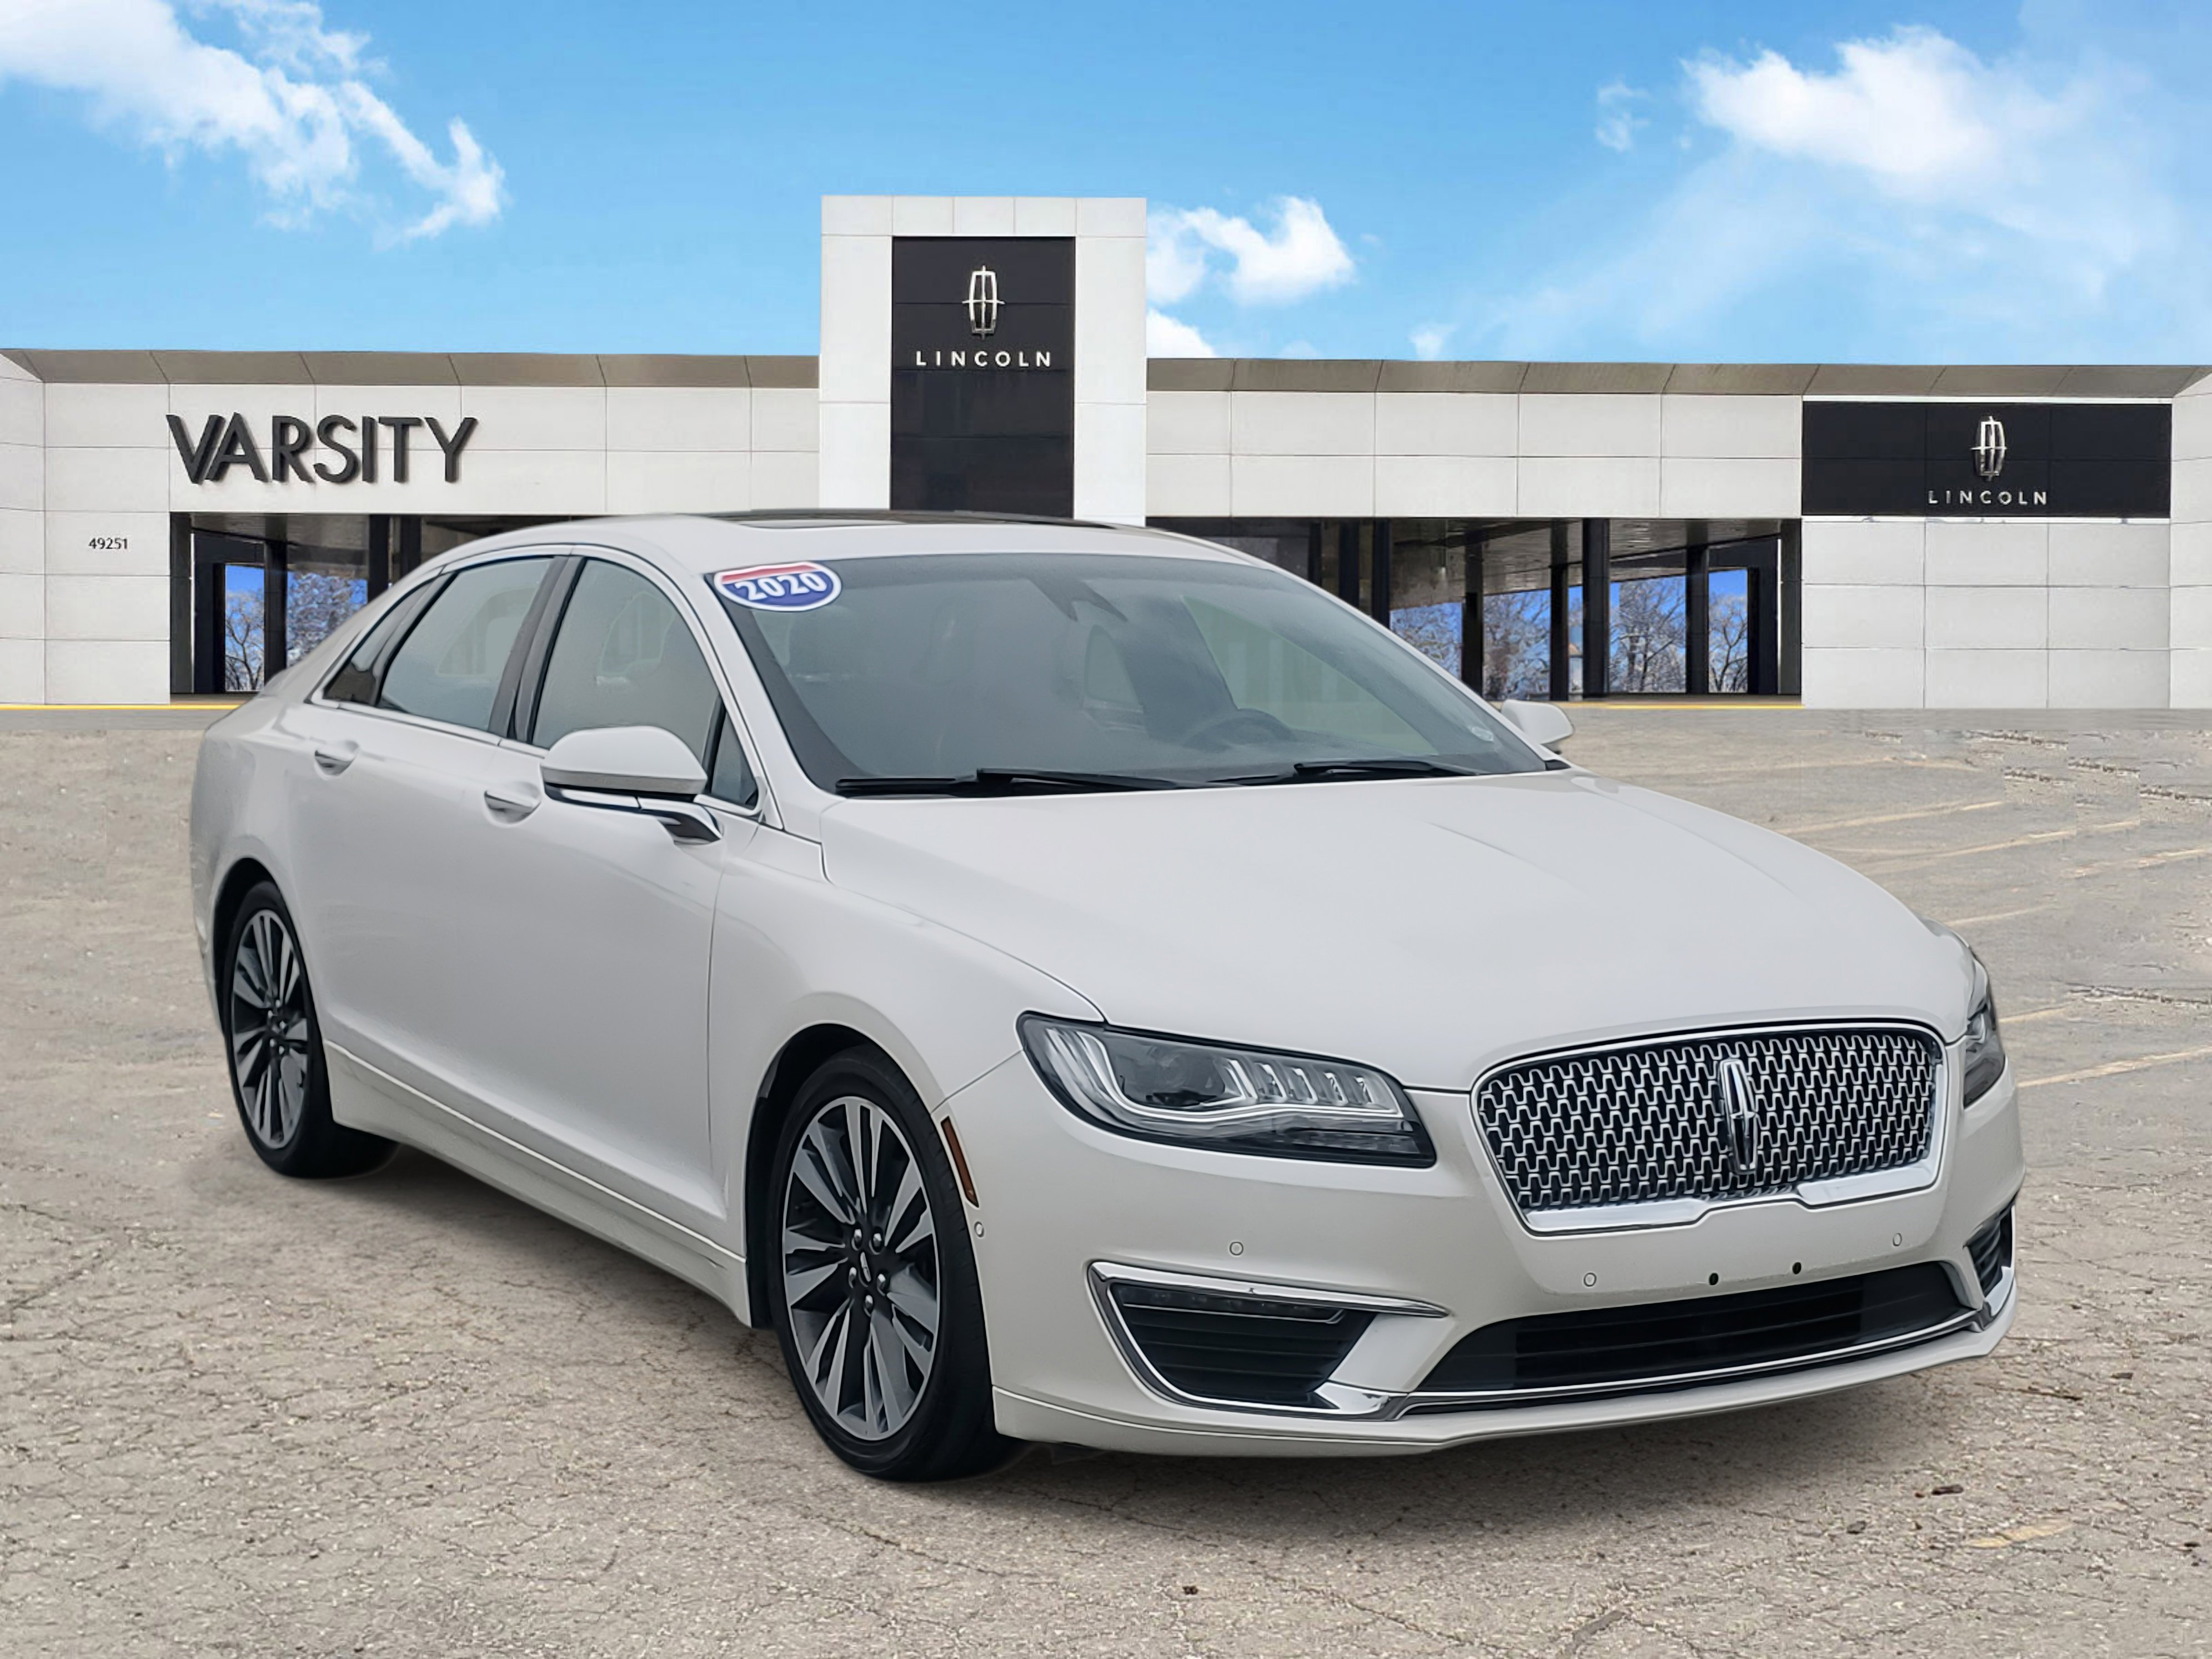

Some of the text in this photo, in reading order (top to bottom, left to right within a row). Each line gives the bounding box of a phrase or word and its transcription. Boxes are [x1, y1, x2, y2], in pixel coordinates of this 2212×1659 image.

[916, 350, 1051, 367] LINCOLN
[166, 412, 479, 484] VARSITY
[1928, 490, 2047, 504] LINCOLN
[88, 537, 128, 549] 49251
[736, 573, 827, 600] 2020
